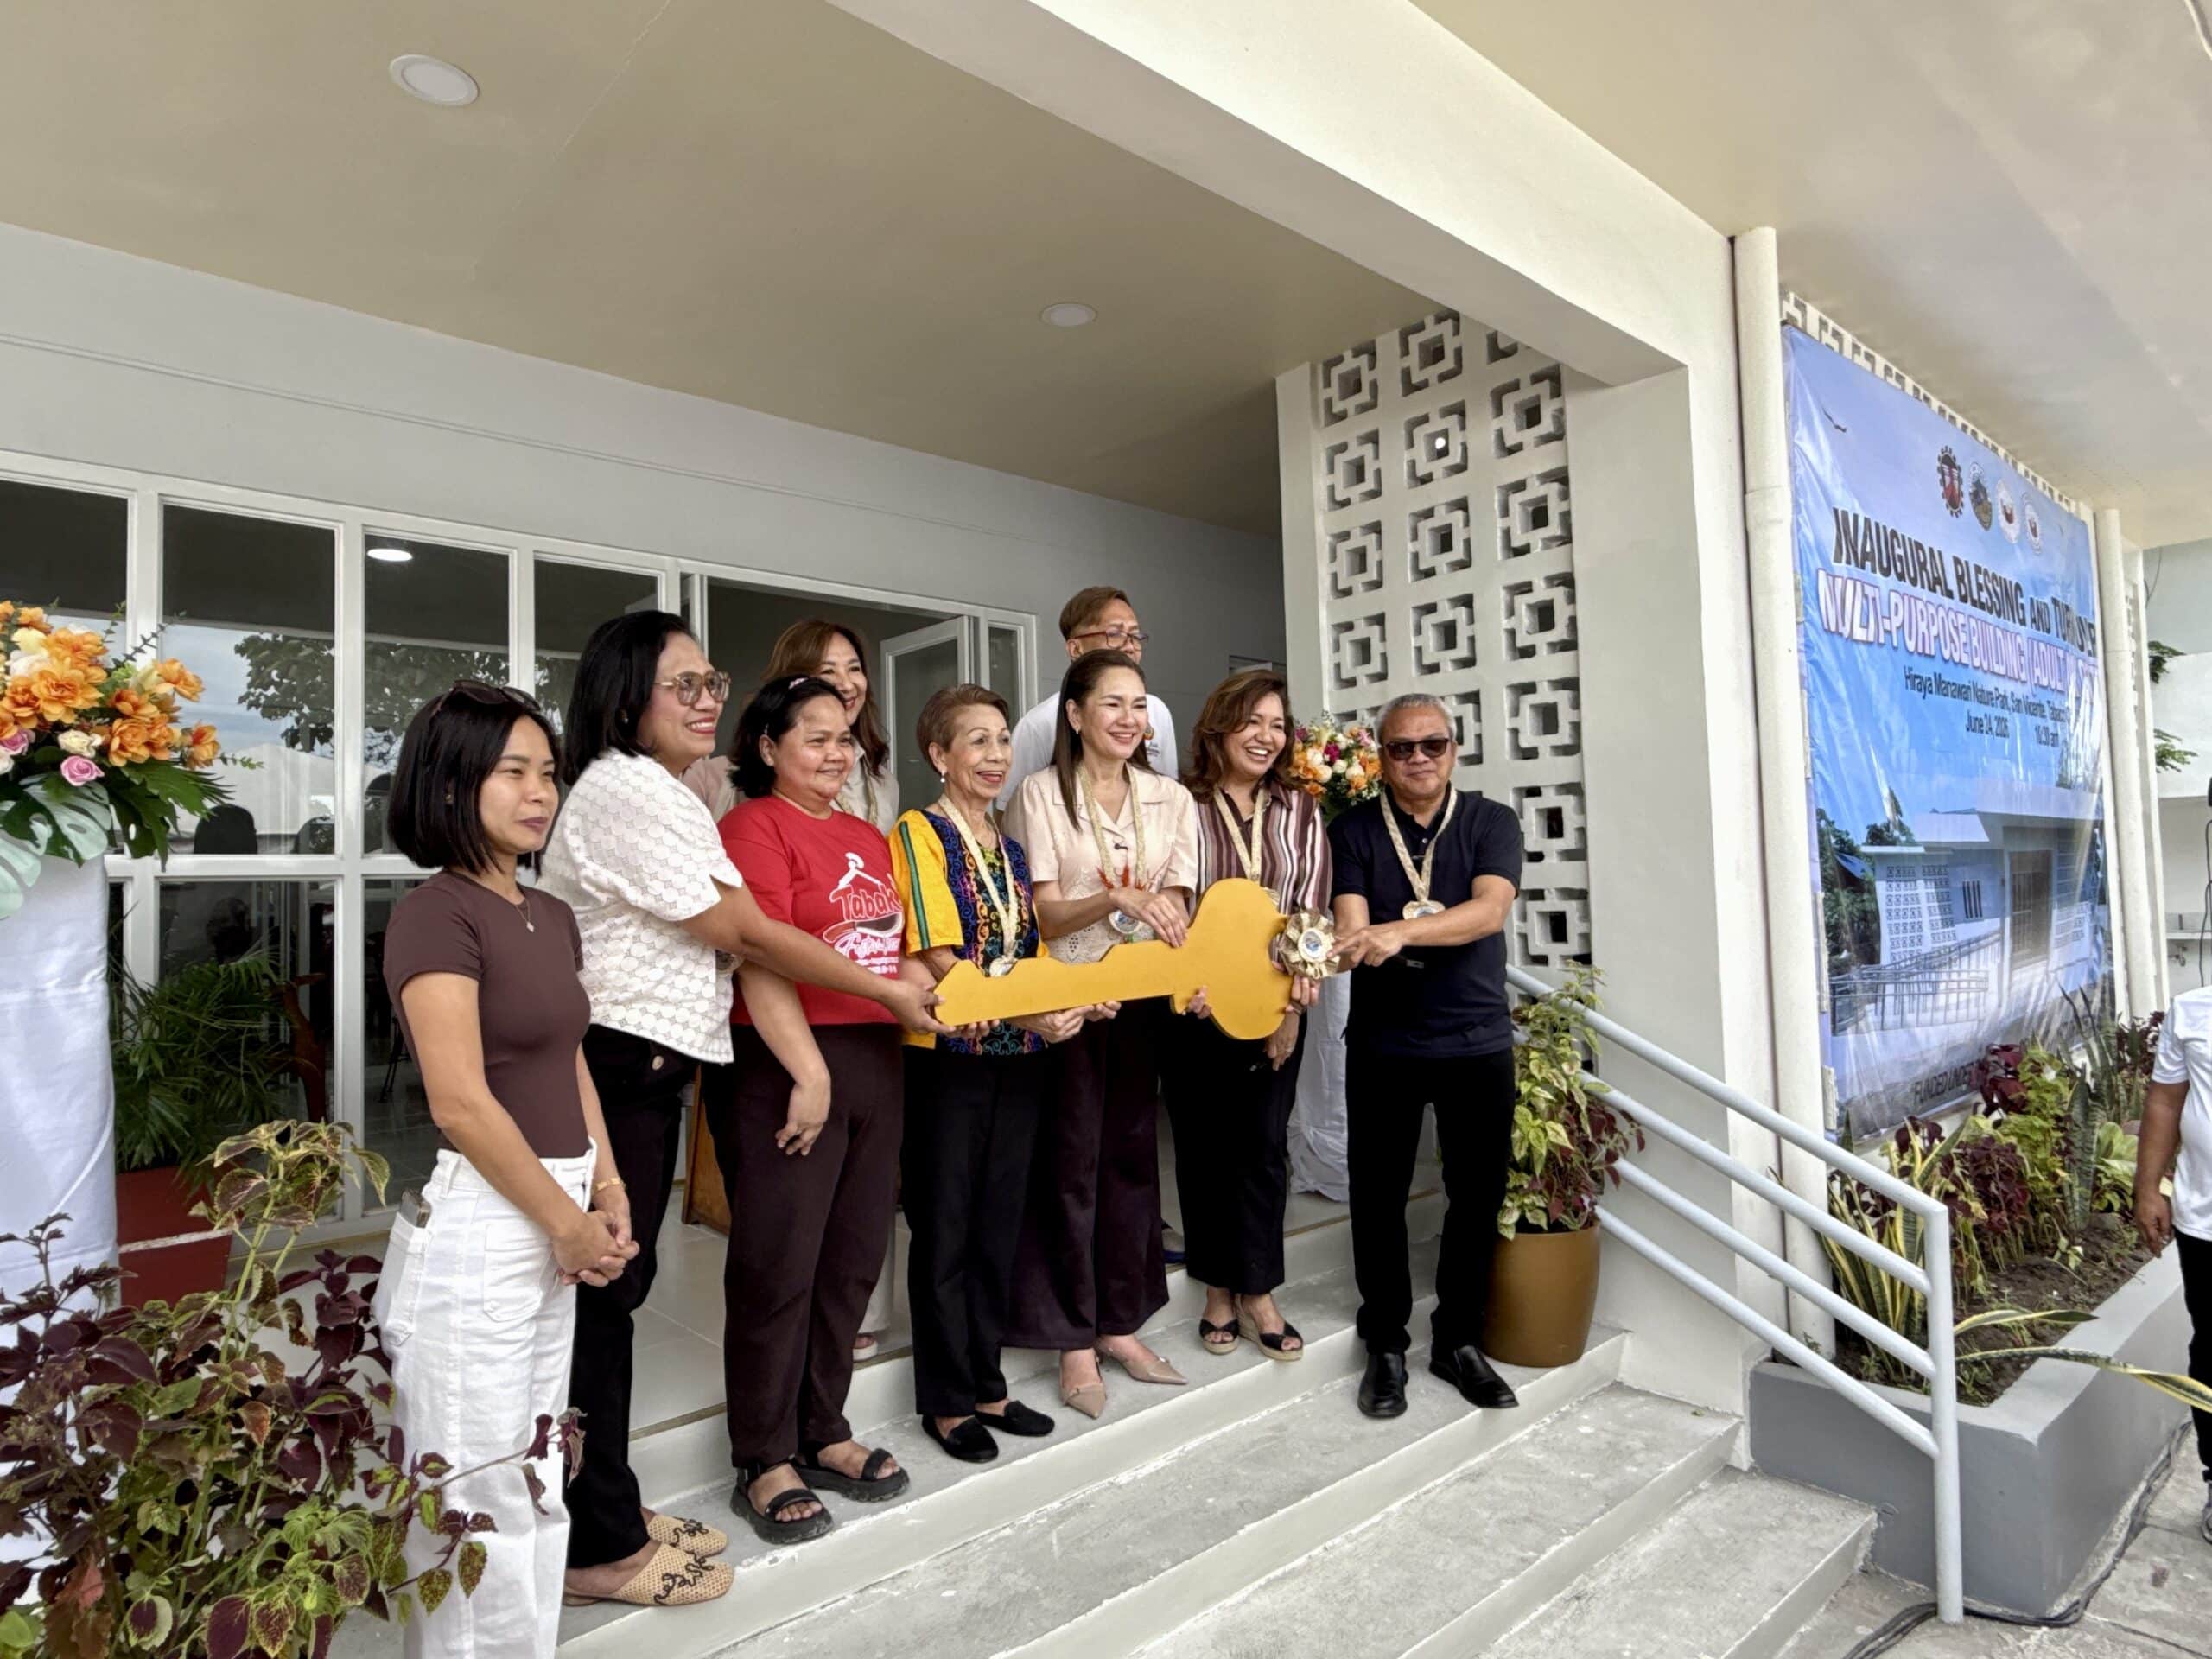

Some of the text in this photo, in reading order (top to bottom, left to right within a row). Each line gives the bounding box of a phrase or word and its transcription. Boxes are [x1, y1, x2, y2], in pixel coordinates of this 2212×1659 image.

[1833, 506, 1954, 599] INAUGURAL
[1952, 556, 2026, 626] BLESSING
[2030, 596, 2051, 634] AND
[1968, 614, 2027, 683] BUILDING
[1904, 664, 1933, 700] Hiraya
[1966, 709, 1984, 734] June
